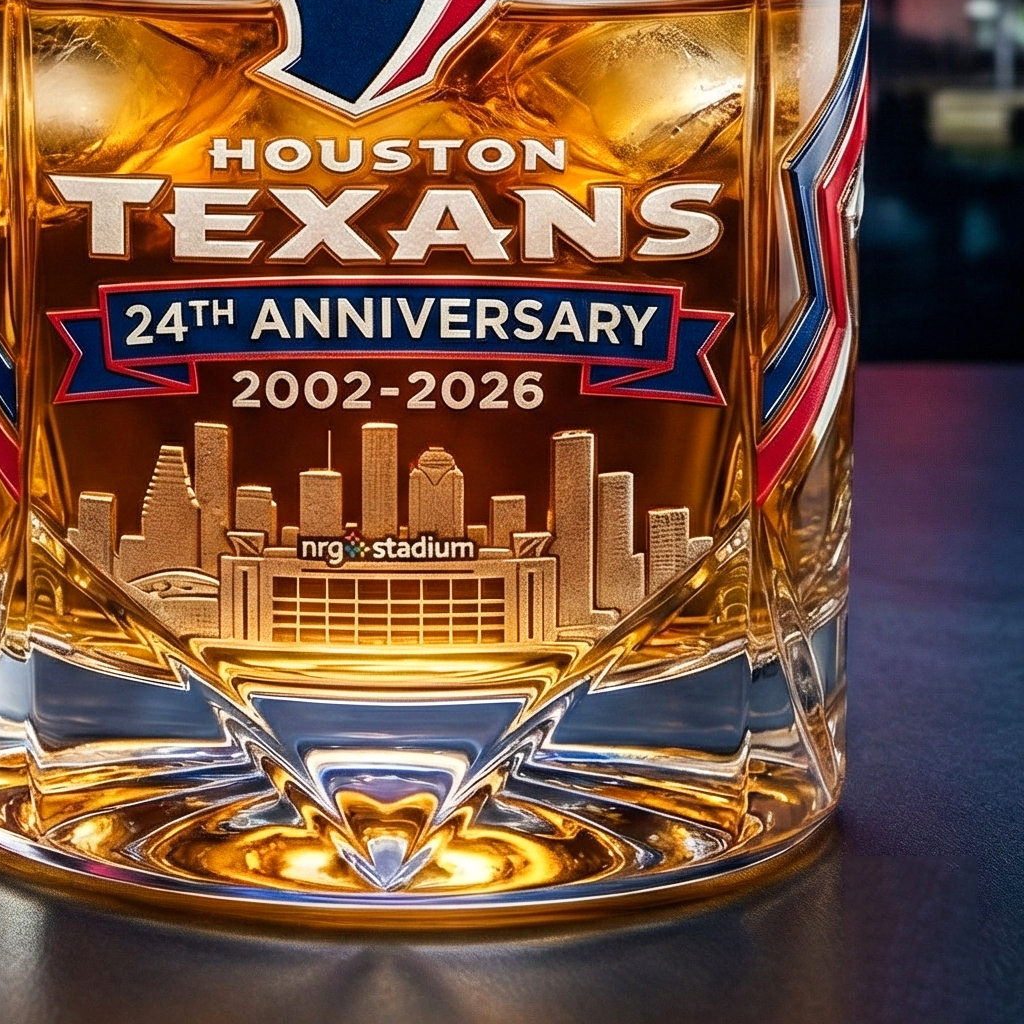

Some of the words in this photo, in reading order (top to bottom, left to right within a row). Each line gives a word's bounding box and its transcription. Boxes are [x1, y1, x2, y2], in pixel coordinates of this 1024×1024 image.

[209, 137, 567, 174] HOUSTON
[48, 174, 726, 264] TEXANS
[124, 298, 236, 347] 24TH
[250, 296, 659, 347] ANNIVERSARY
[230, 369, 546, 411] 2002-2026
[301, 540, 344, 565] nrg
[372, 536, 475, 559] stadium
